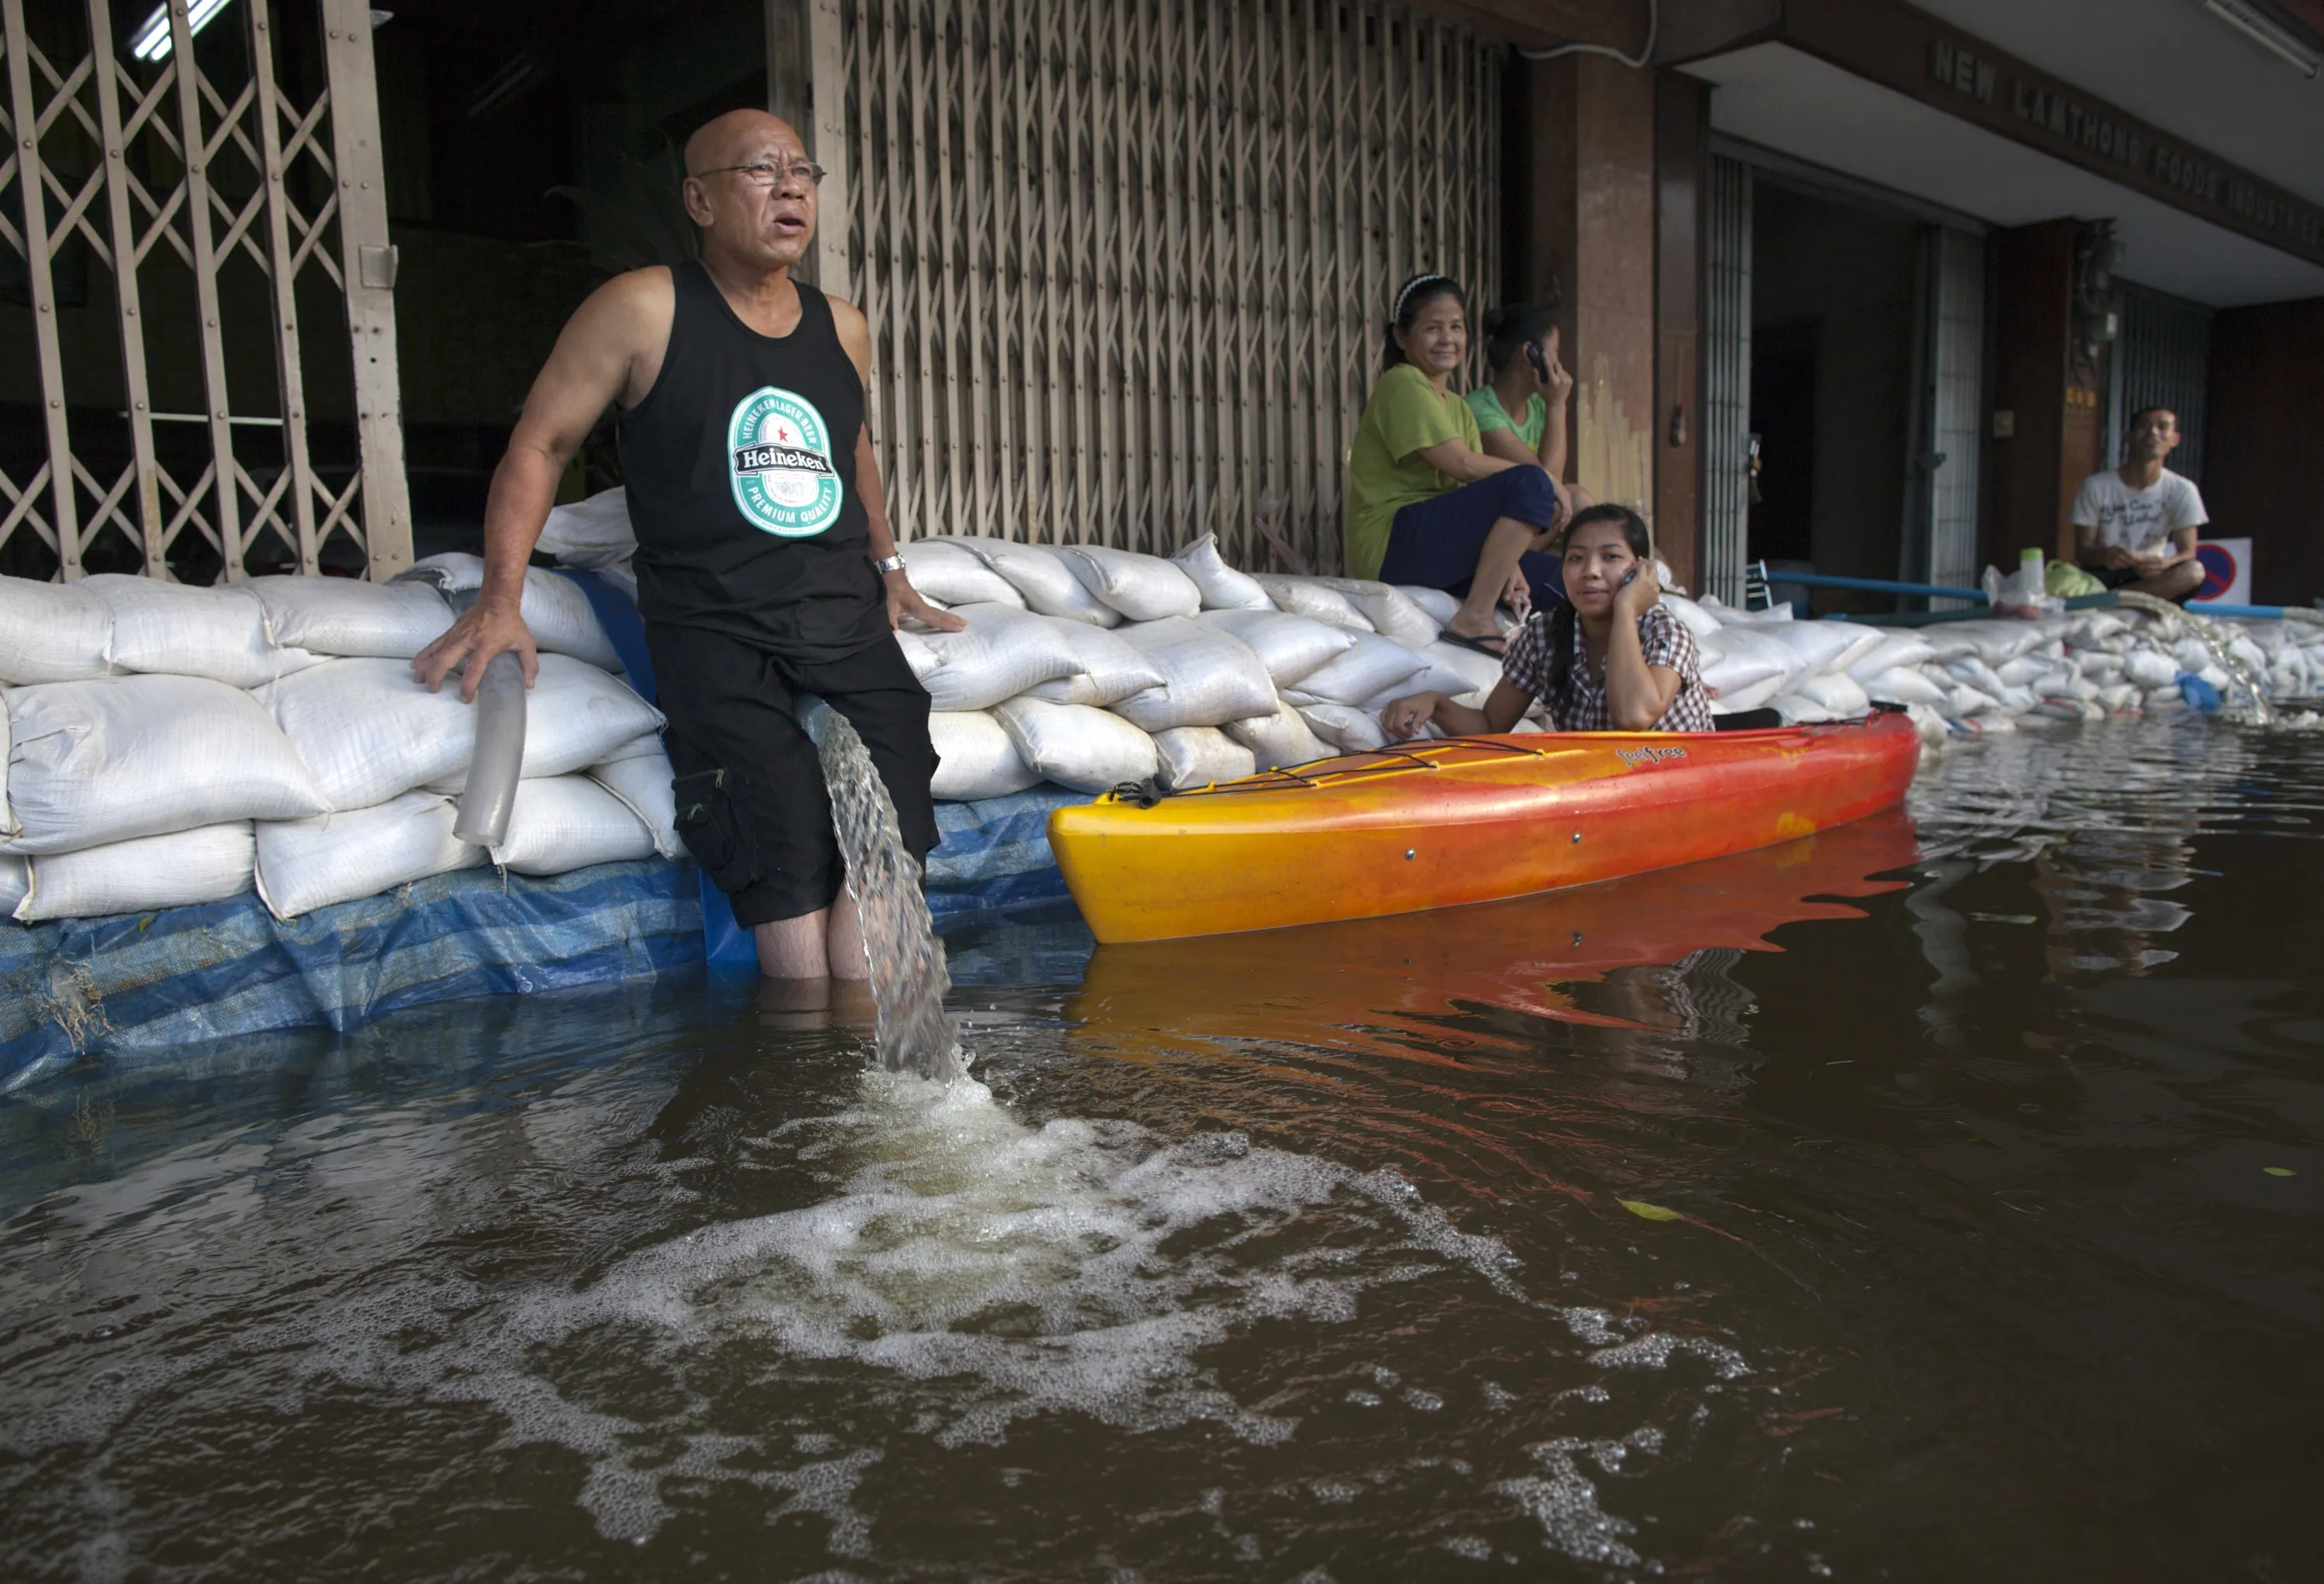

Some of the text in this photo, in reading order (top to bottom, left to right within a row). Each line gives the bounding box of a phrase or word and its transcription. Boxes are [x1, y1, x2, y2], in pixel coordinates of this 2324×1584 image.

[1935, 40, 1997, 105] NEW
[2156, 146, 2219, 201] FOODS
[2228, 179, 2319, 246] INDUSTRES
[742, 398, 817, 445] HEINEKEN LAGER BEER
[742, 447, 827, 472] Heineken
[748, 486, 796, 524] PREMIUM
[800, 486, 833, 523] QUALITY
